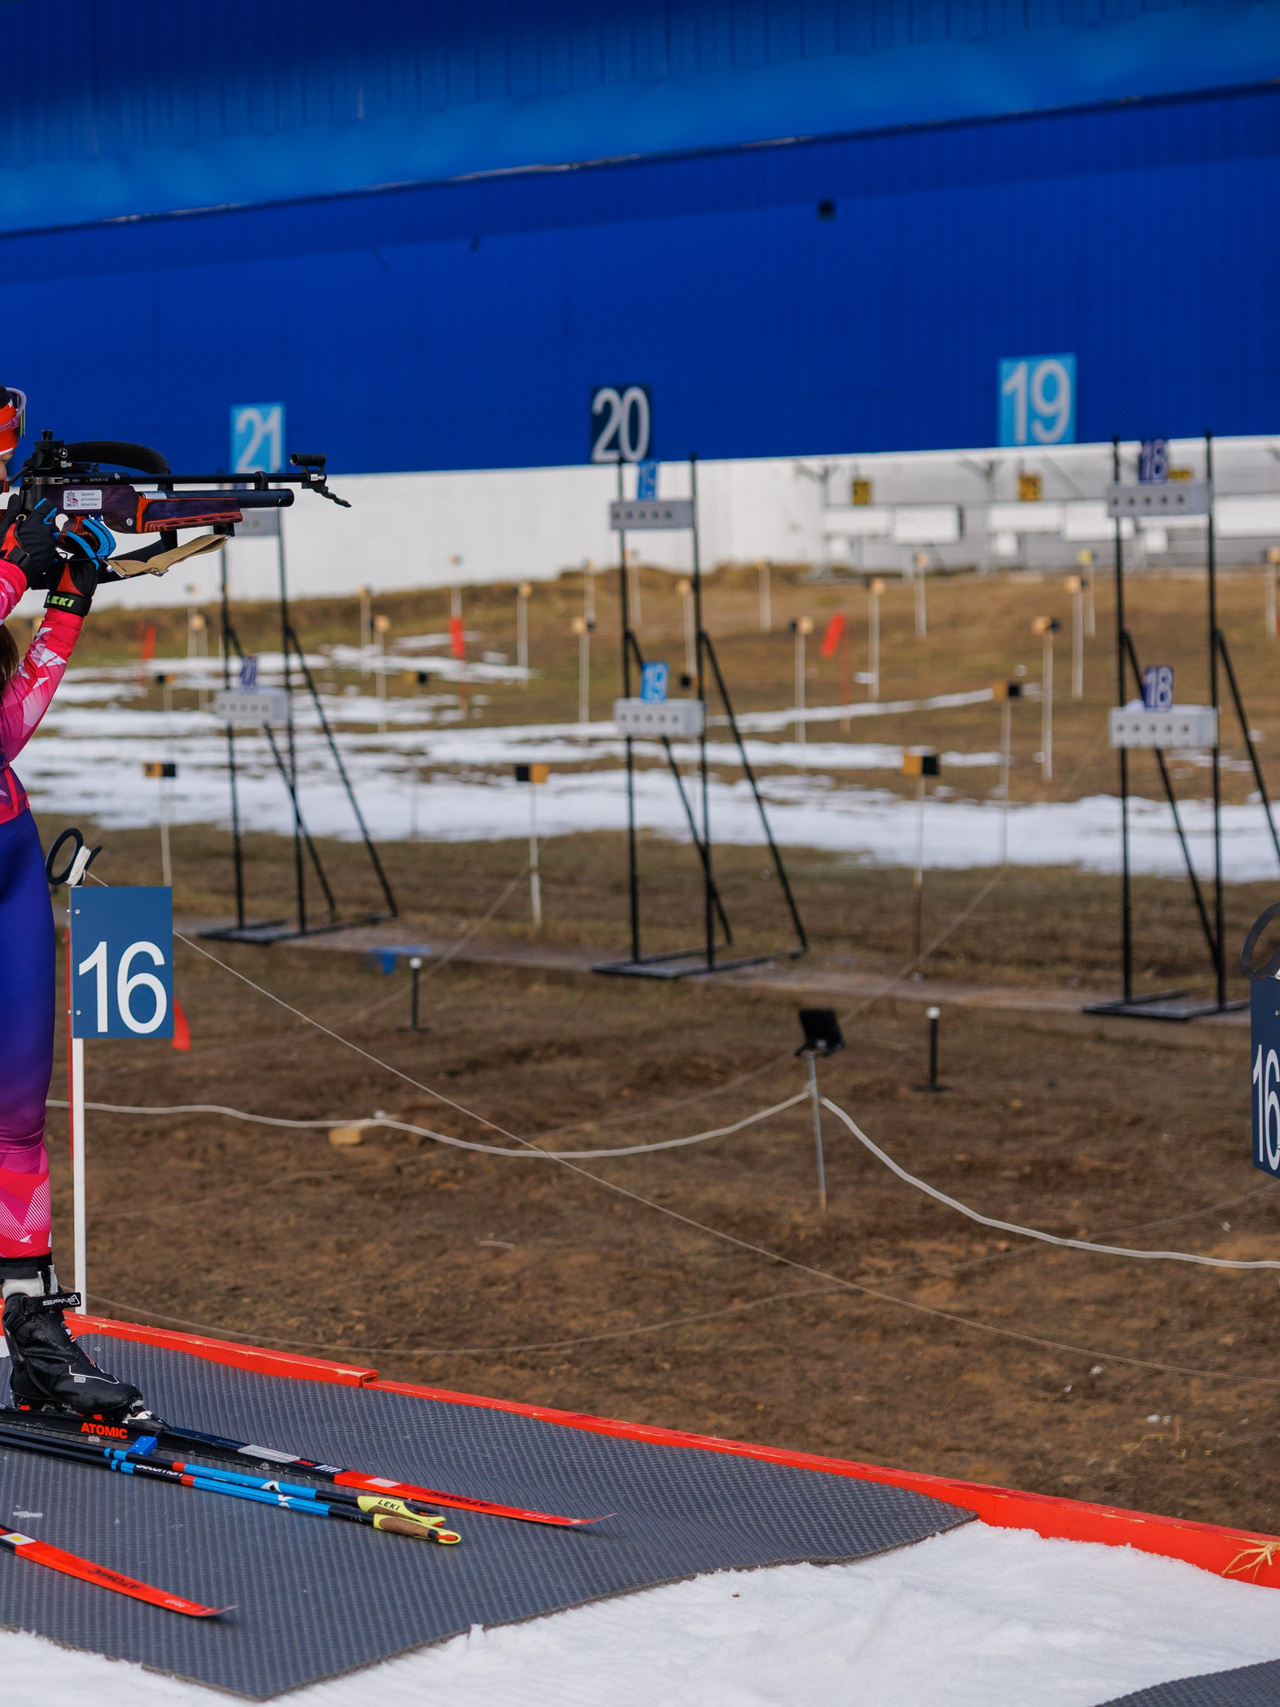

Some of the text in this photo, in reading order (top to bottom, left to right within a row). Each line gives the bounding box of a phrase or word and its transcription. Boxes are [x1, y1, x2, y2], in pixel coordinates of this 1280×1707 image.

[592, 386, 650, 462] 20
[1001, 359, 1071, 445] 19
[235, 406, 282, 473] 21
[46, 594, 74, 607] LEKI
[1143, 666, 1173, 711] 18
[78, 941, 167, 1034] 16
[1253, 1044, 1280, 1171] 16
[81, 1422, 128, 1439] ATOMIC
[377, 1498, 400, 1511] LEKI
